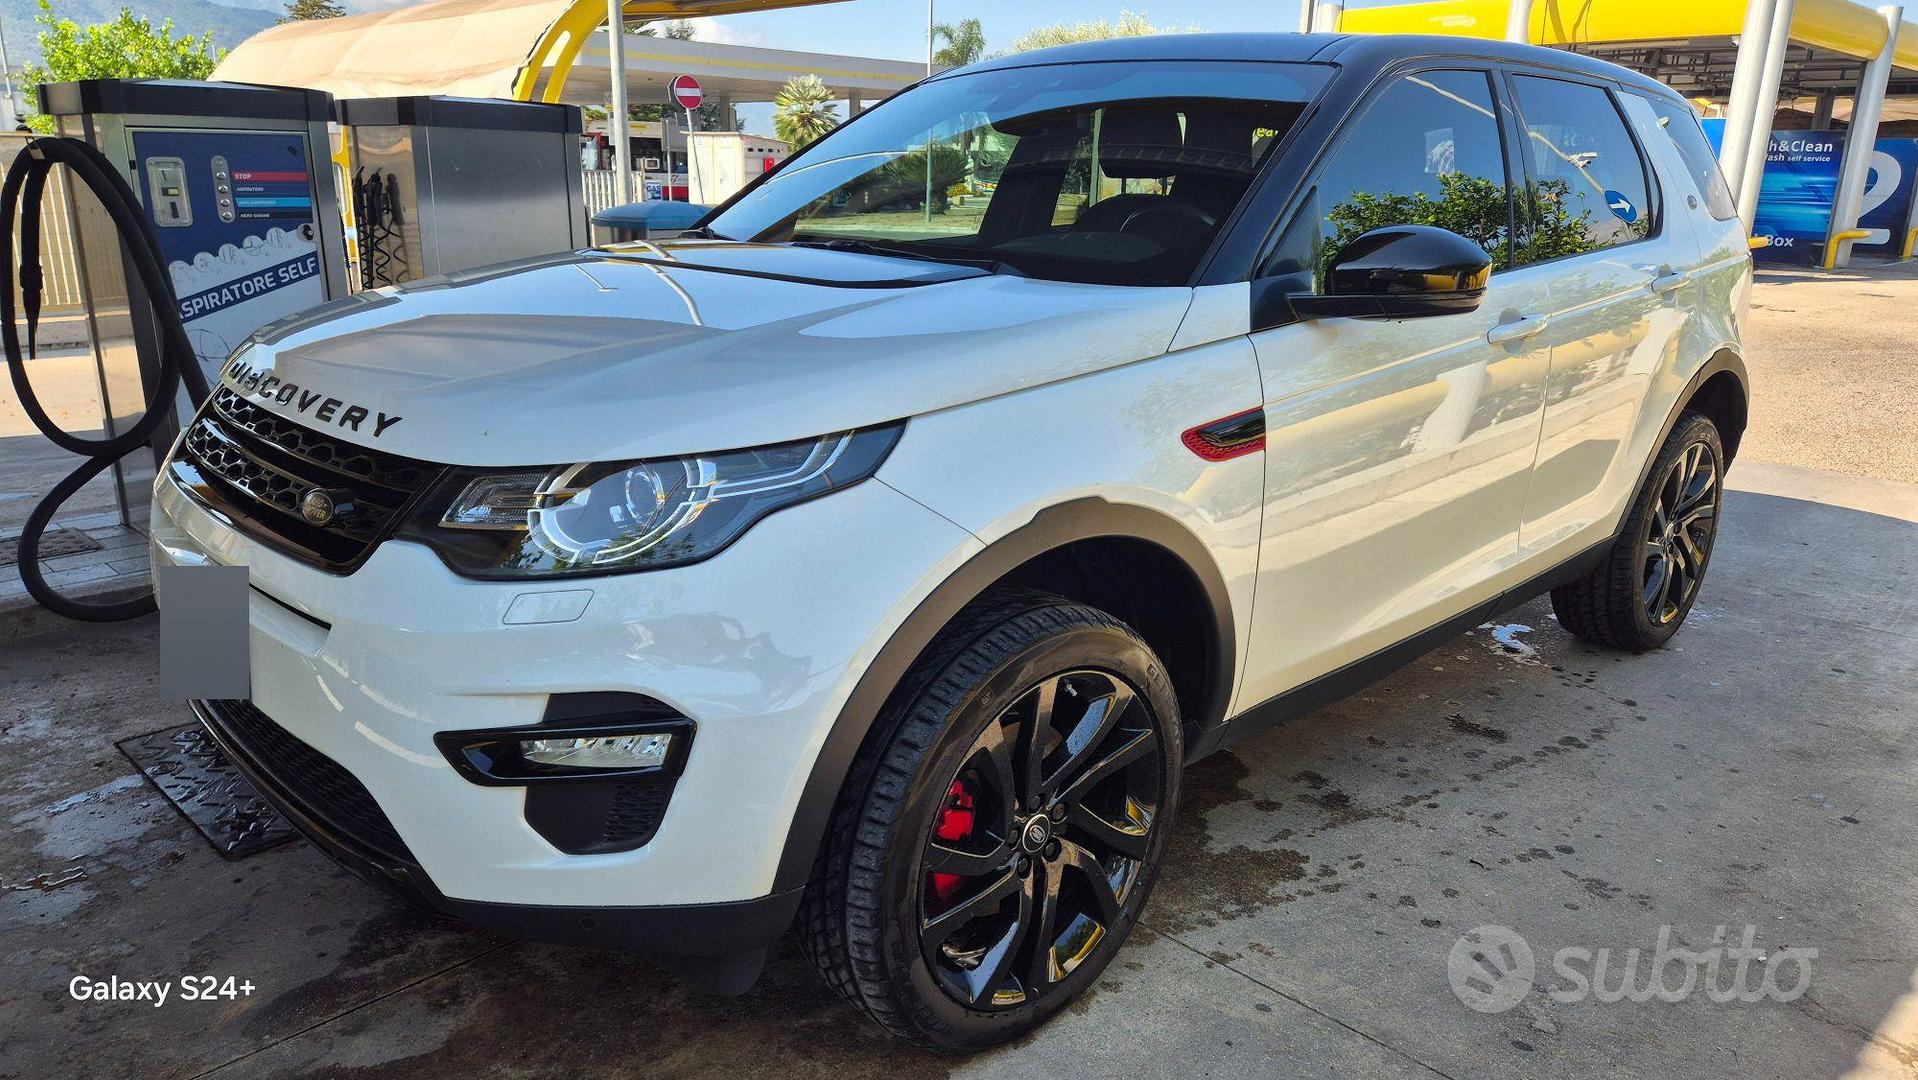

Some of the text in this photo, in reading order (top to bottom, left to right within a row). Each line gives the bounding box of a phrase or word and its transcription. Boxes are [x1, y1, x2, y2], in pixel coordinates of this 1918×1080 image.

[1768, 139, 1833, 152] h&Clean
[1766, 153, 1785, 162] ash
[234, 172, 252, 180] STOP
[278, 257, 316, 283] SELF
[228, 361, 403, 438] DISCOVERY
